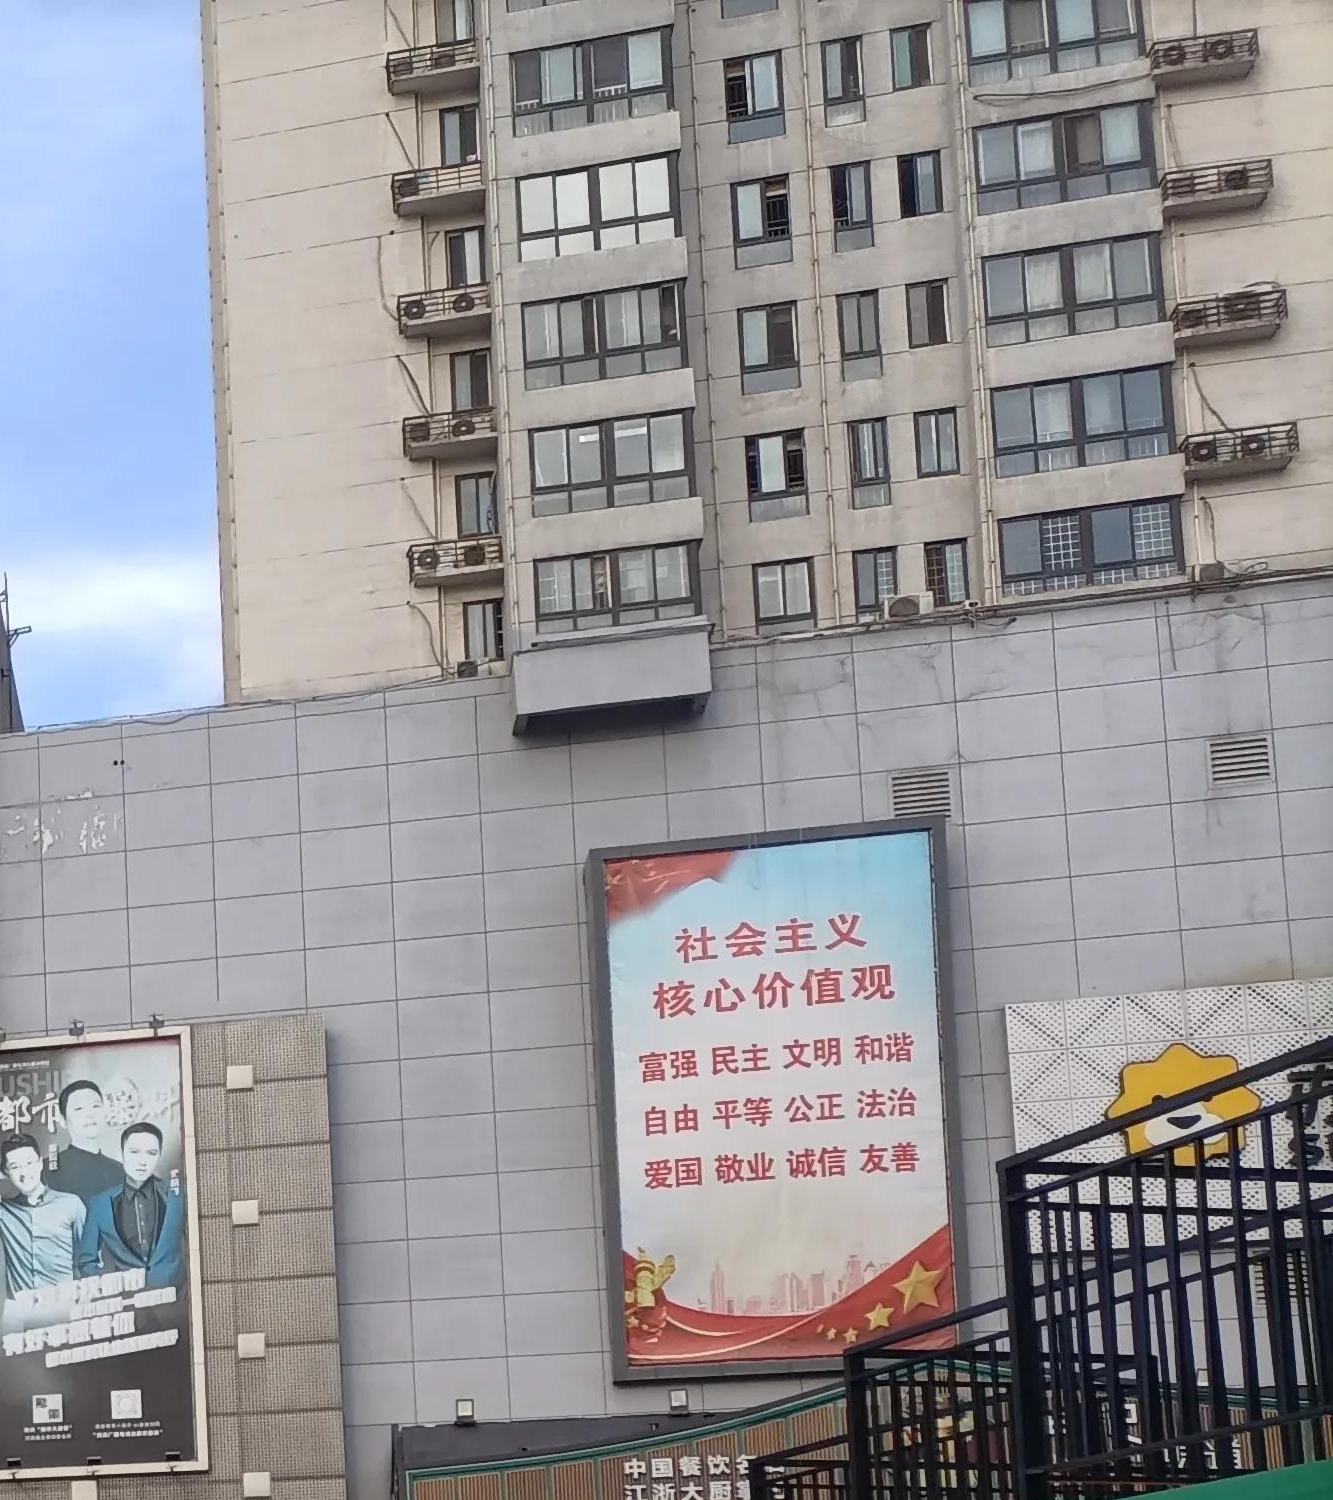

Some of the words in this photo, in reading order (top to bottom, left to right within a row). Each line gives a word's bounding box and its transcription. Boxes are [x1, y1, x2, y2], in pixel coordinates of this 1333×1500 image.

[675, 913, 868, 964] 社会主义
[652, 963, 896, 1020] 核心价值观
[638, 1050, 699, 1084] 富强
[710, 1043, 771, 1077] 民主
[782, 1037, 843, 1070] 文明
[854, 1031, 915, 1066] 和谐
[644, 1103, 700, 1137] 自由
[712, 1097, 773, 1130] 平等
[784, 1092, 845, 1125] 公正
[857, 1086, 917, 1120] 法治
[644, 1157, 703, 1190] 爱国
[714, 1152, 775, 1185] 敬业
[786, 1146, 848, 1179] 诚信
[859, 1141, 921, 1174] 友善
